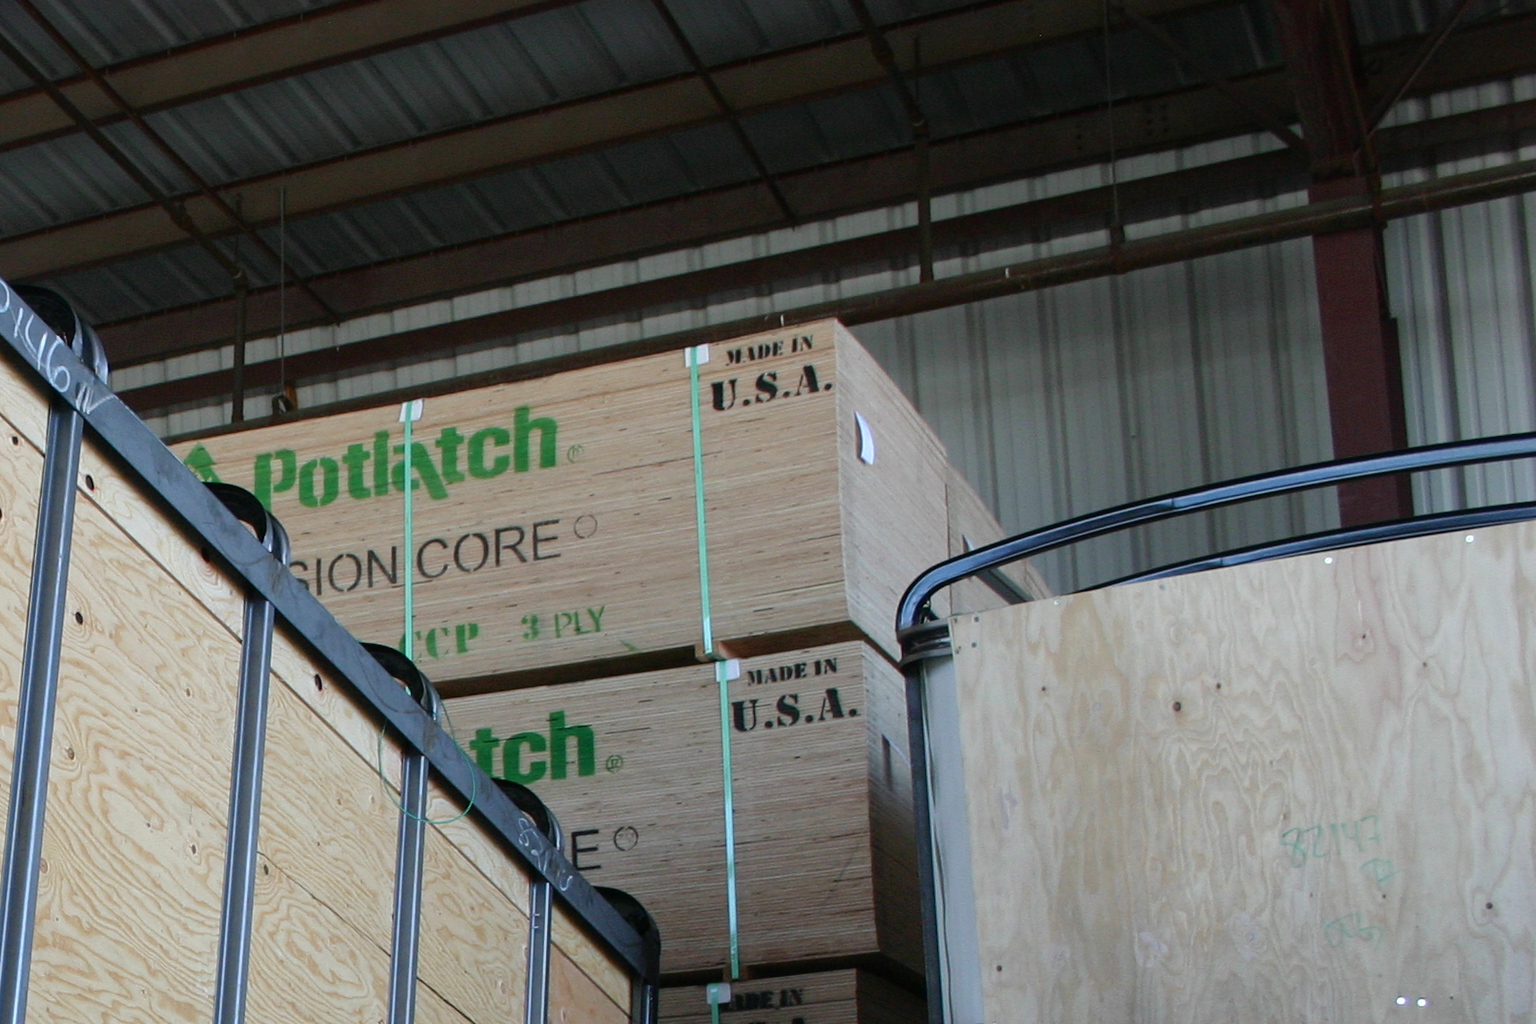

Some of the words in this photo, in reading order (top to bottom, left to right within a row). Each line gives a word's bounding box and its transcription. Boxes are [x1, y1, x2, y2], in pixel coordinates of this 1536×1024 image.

[726, 341, 784, 366] MADE
[791, 335, 814, 353] IN
[711, 364, 833, 412] U.S.A.
[253, 405, 558, 512] Potlatch
[416, 518, 562, 579] CORE
[554, 605, 606, 640] PLY
[747, 662, 807, 686] MADE
[814, 657, 837, 676] IN
[731, 687, 858, 732] U.S.A.
[469, 710, 595, 785] tch
[720, 990, 774, 1012] ADE
[779, 988, 802, 1007] IN
